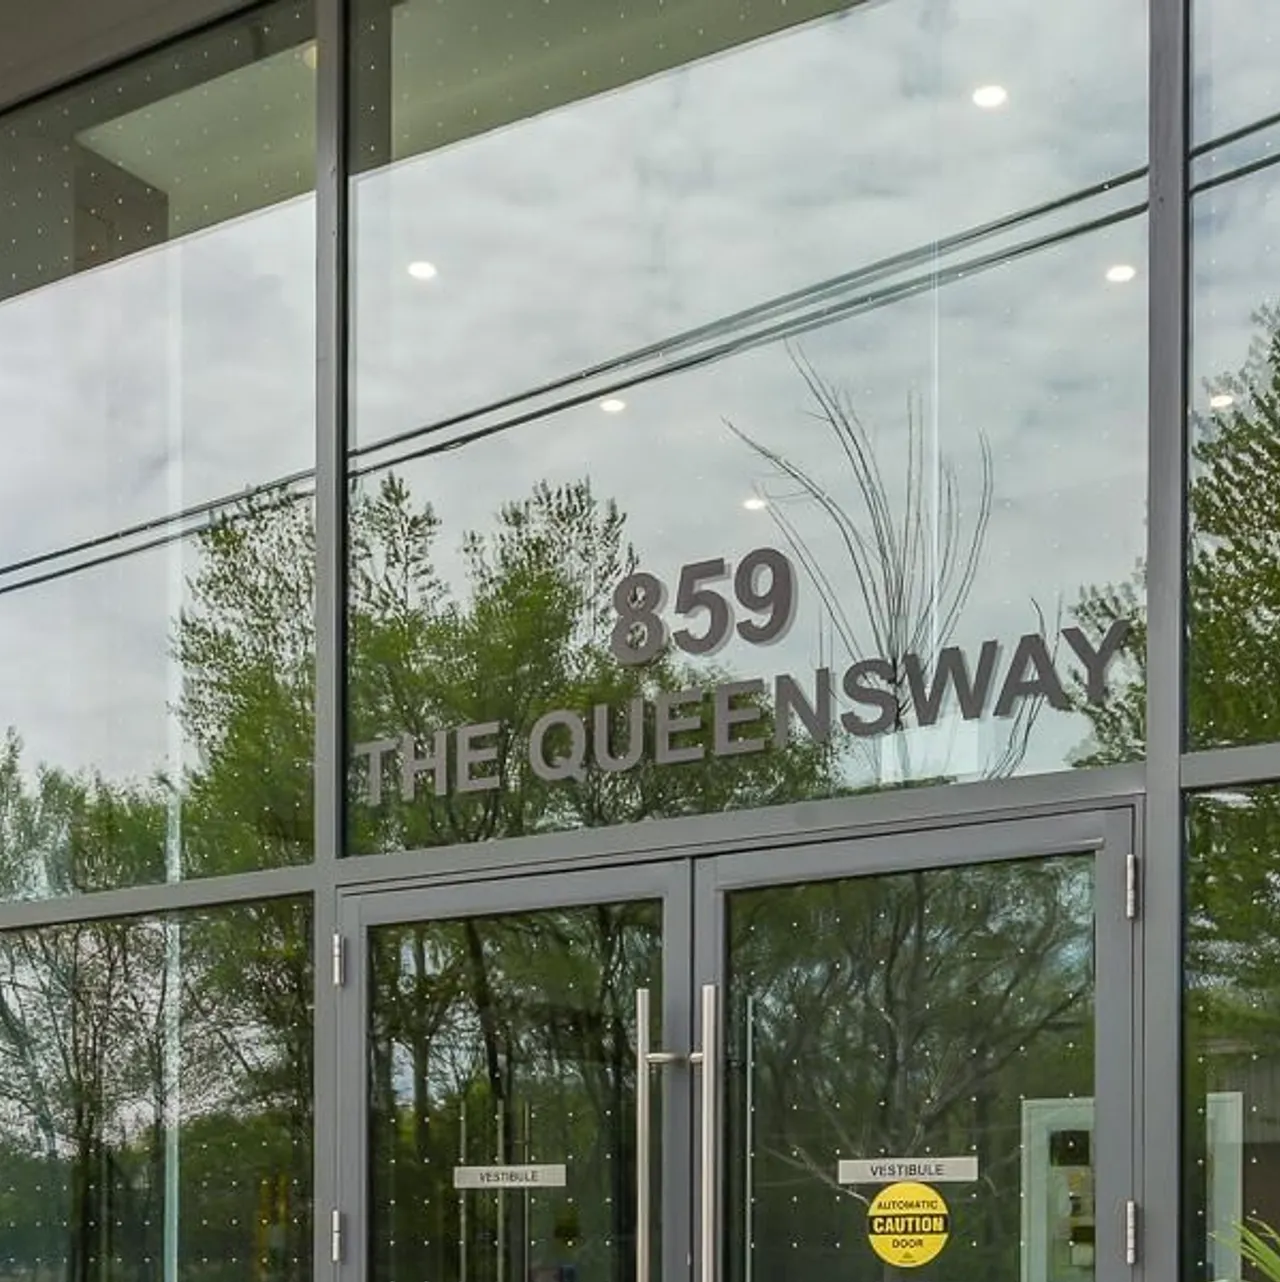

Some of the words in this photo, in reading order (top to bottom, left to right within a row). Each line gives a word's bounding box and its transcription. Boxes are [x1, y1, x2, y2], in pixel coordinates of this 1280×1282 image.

[610, 547, 796, 665] 859
[353, 721, 502, 806] THE
[530, 619, 1131, 781] QUEENSWAY
[479, 1171, 538, 1183] VESTIBULE
[870, 1164, 945, 1177] VESTIBULE
[877, 1199, 938, 1211] AUTOMATIC
[872, 1216, 945, 1234] CAUTION
[892, 1238, 923, 1249] DOOR
